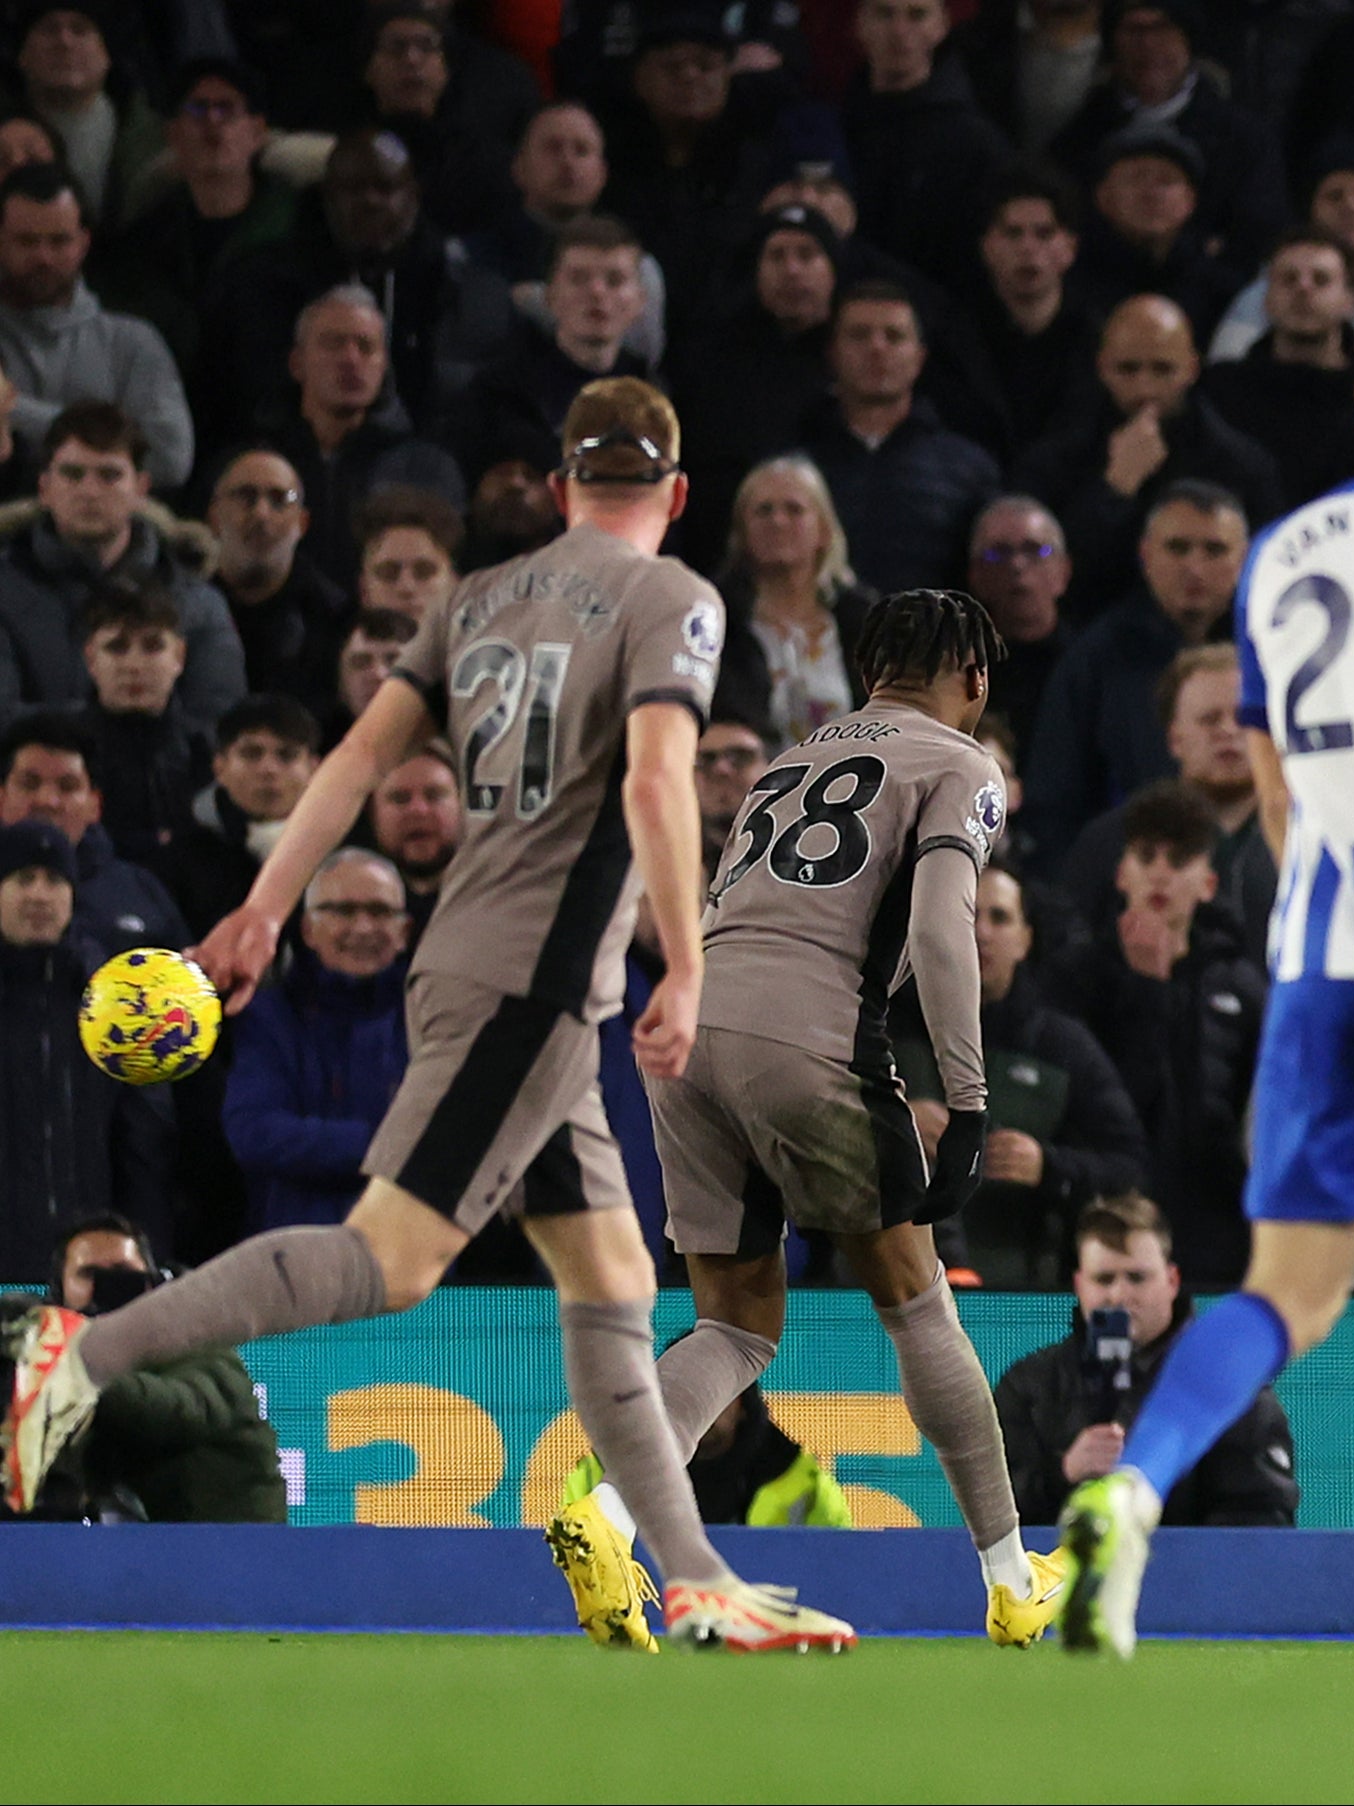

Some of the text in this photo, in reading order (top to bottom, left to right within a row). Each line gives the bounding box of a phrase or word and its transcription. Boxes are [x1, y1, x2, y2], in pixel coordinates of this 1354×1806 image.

[1277, 510, 1352, 568] VAN
[452, 636, 573, 821] 21
[708, 753, 887, 907] 38
